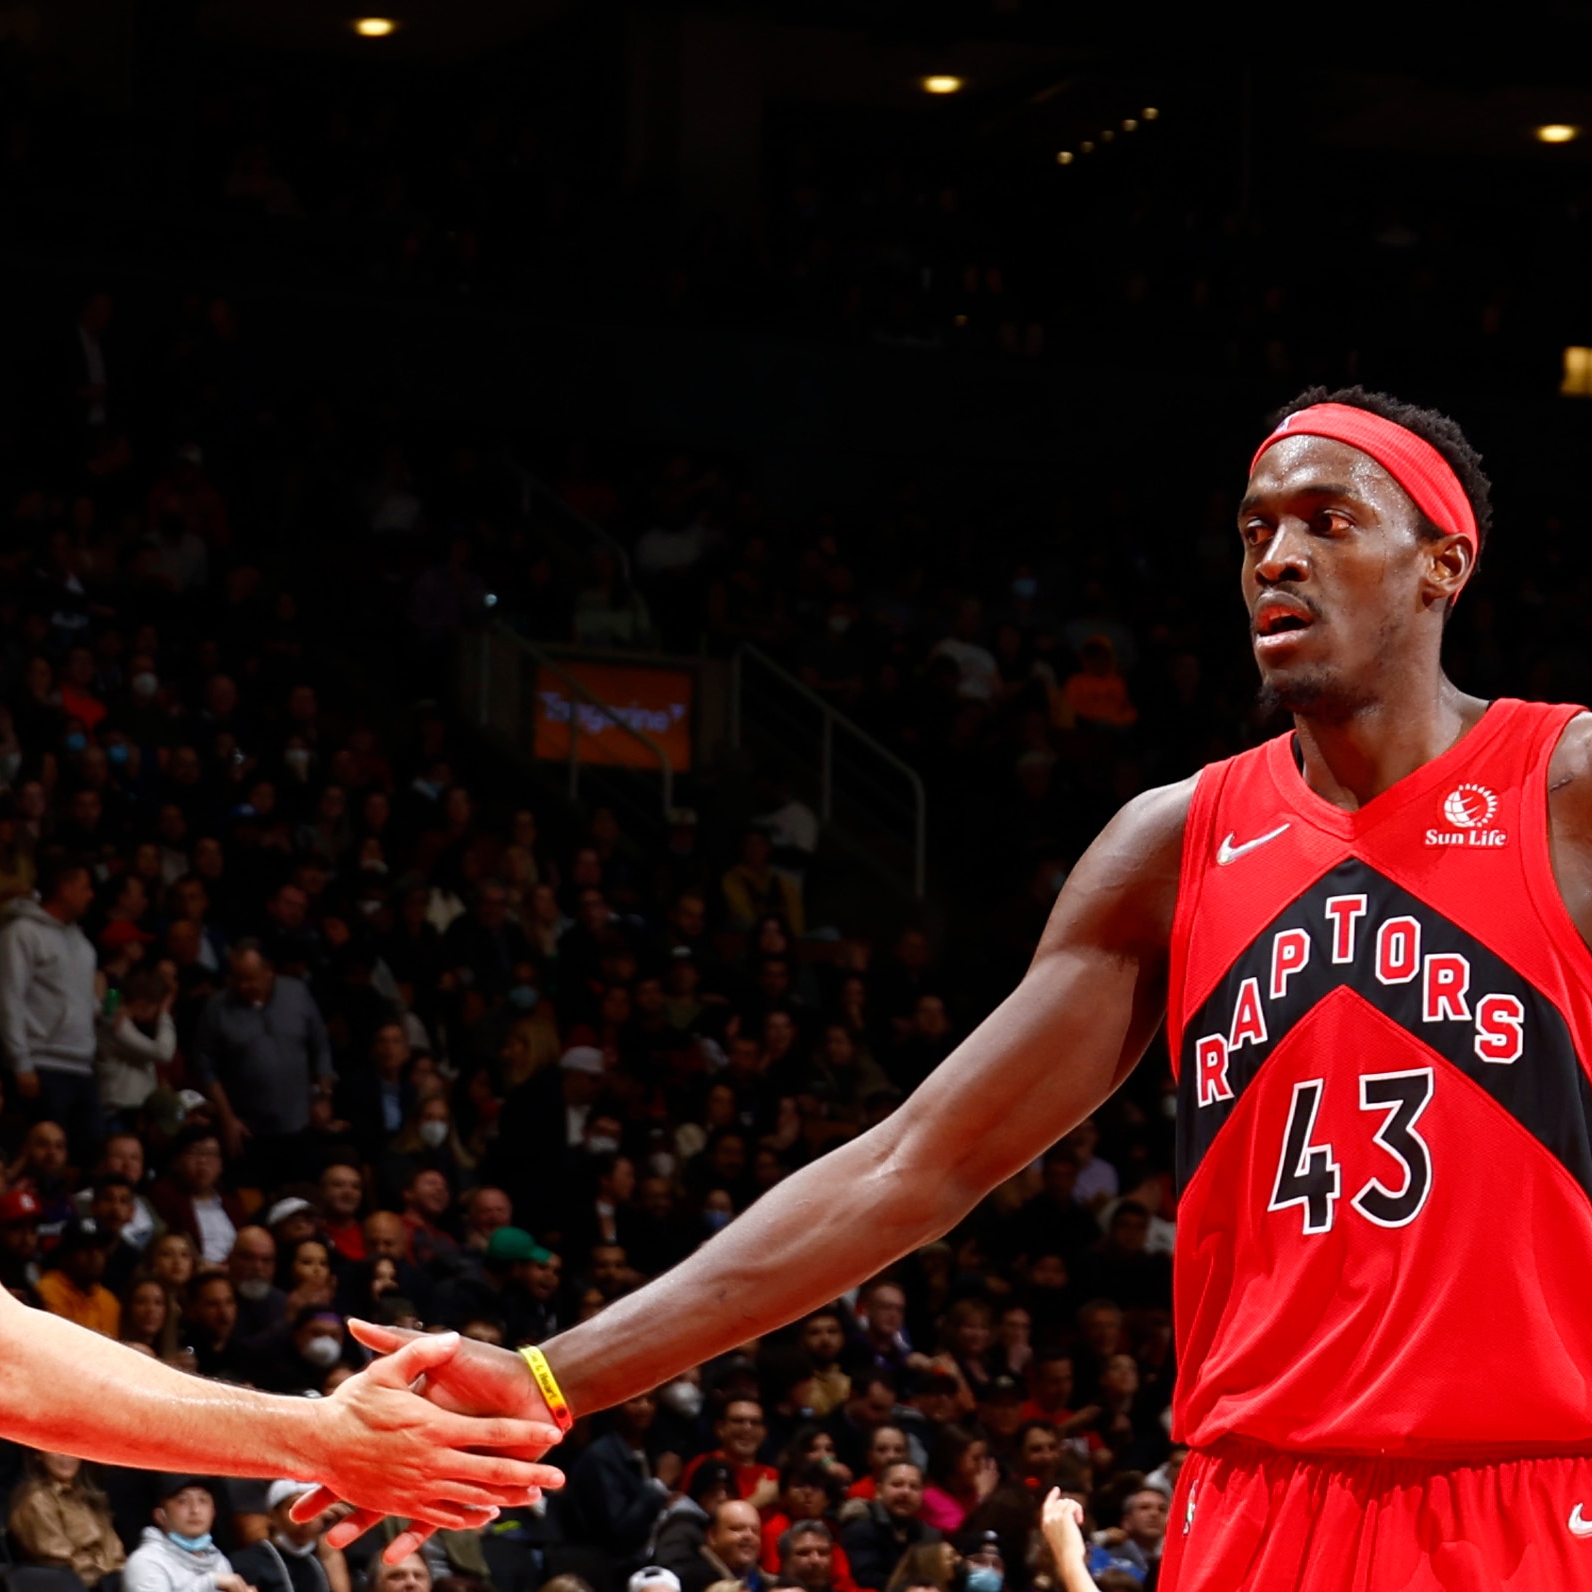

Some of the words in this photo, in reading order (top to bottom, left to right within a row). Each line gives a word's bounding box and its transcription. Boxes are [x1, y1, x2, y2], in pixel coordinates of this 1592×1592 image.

[1423, 828, 1464, 846] Sun
[1468, 828, 1506, 847] Life
[1195, 893, 1525, 1109] RAPTORS
[1267, 1066, 1434, 1236] 43
